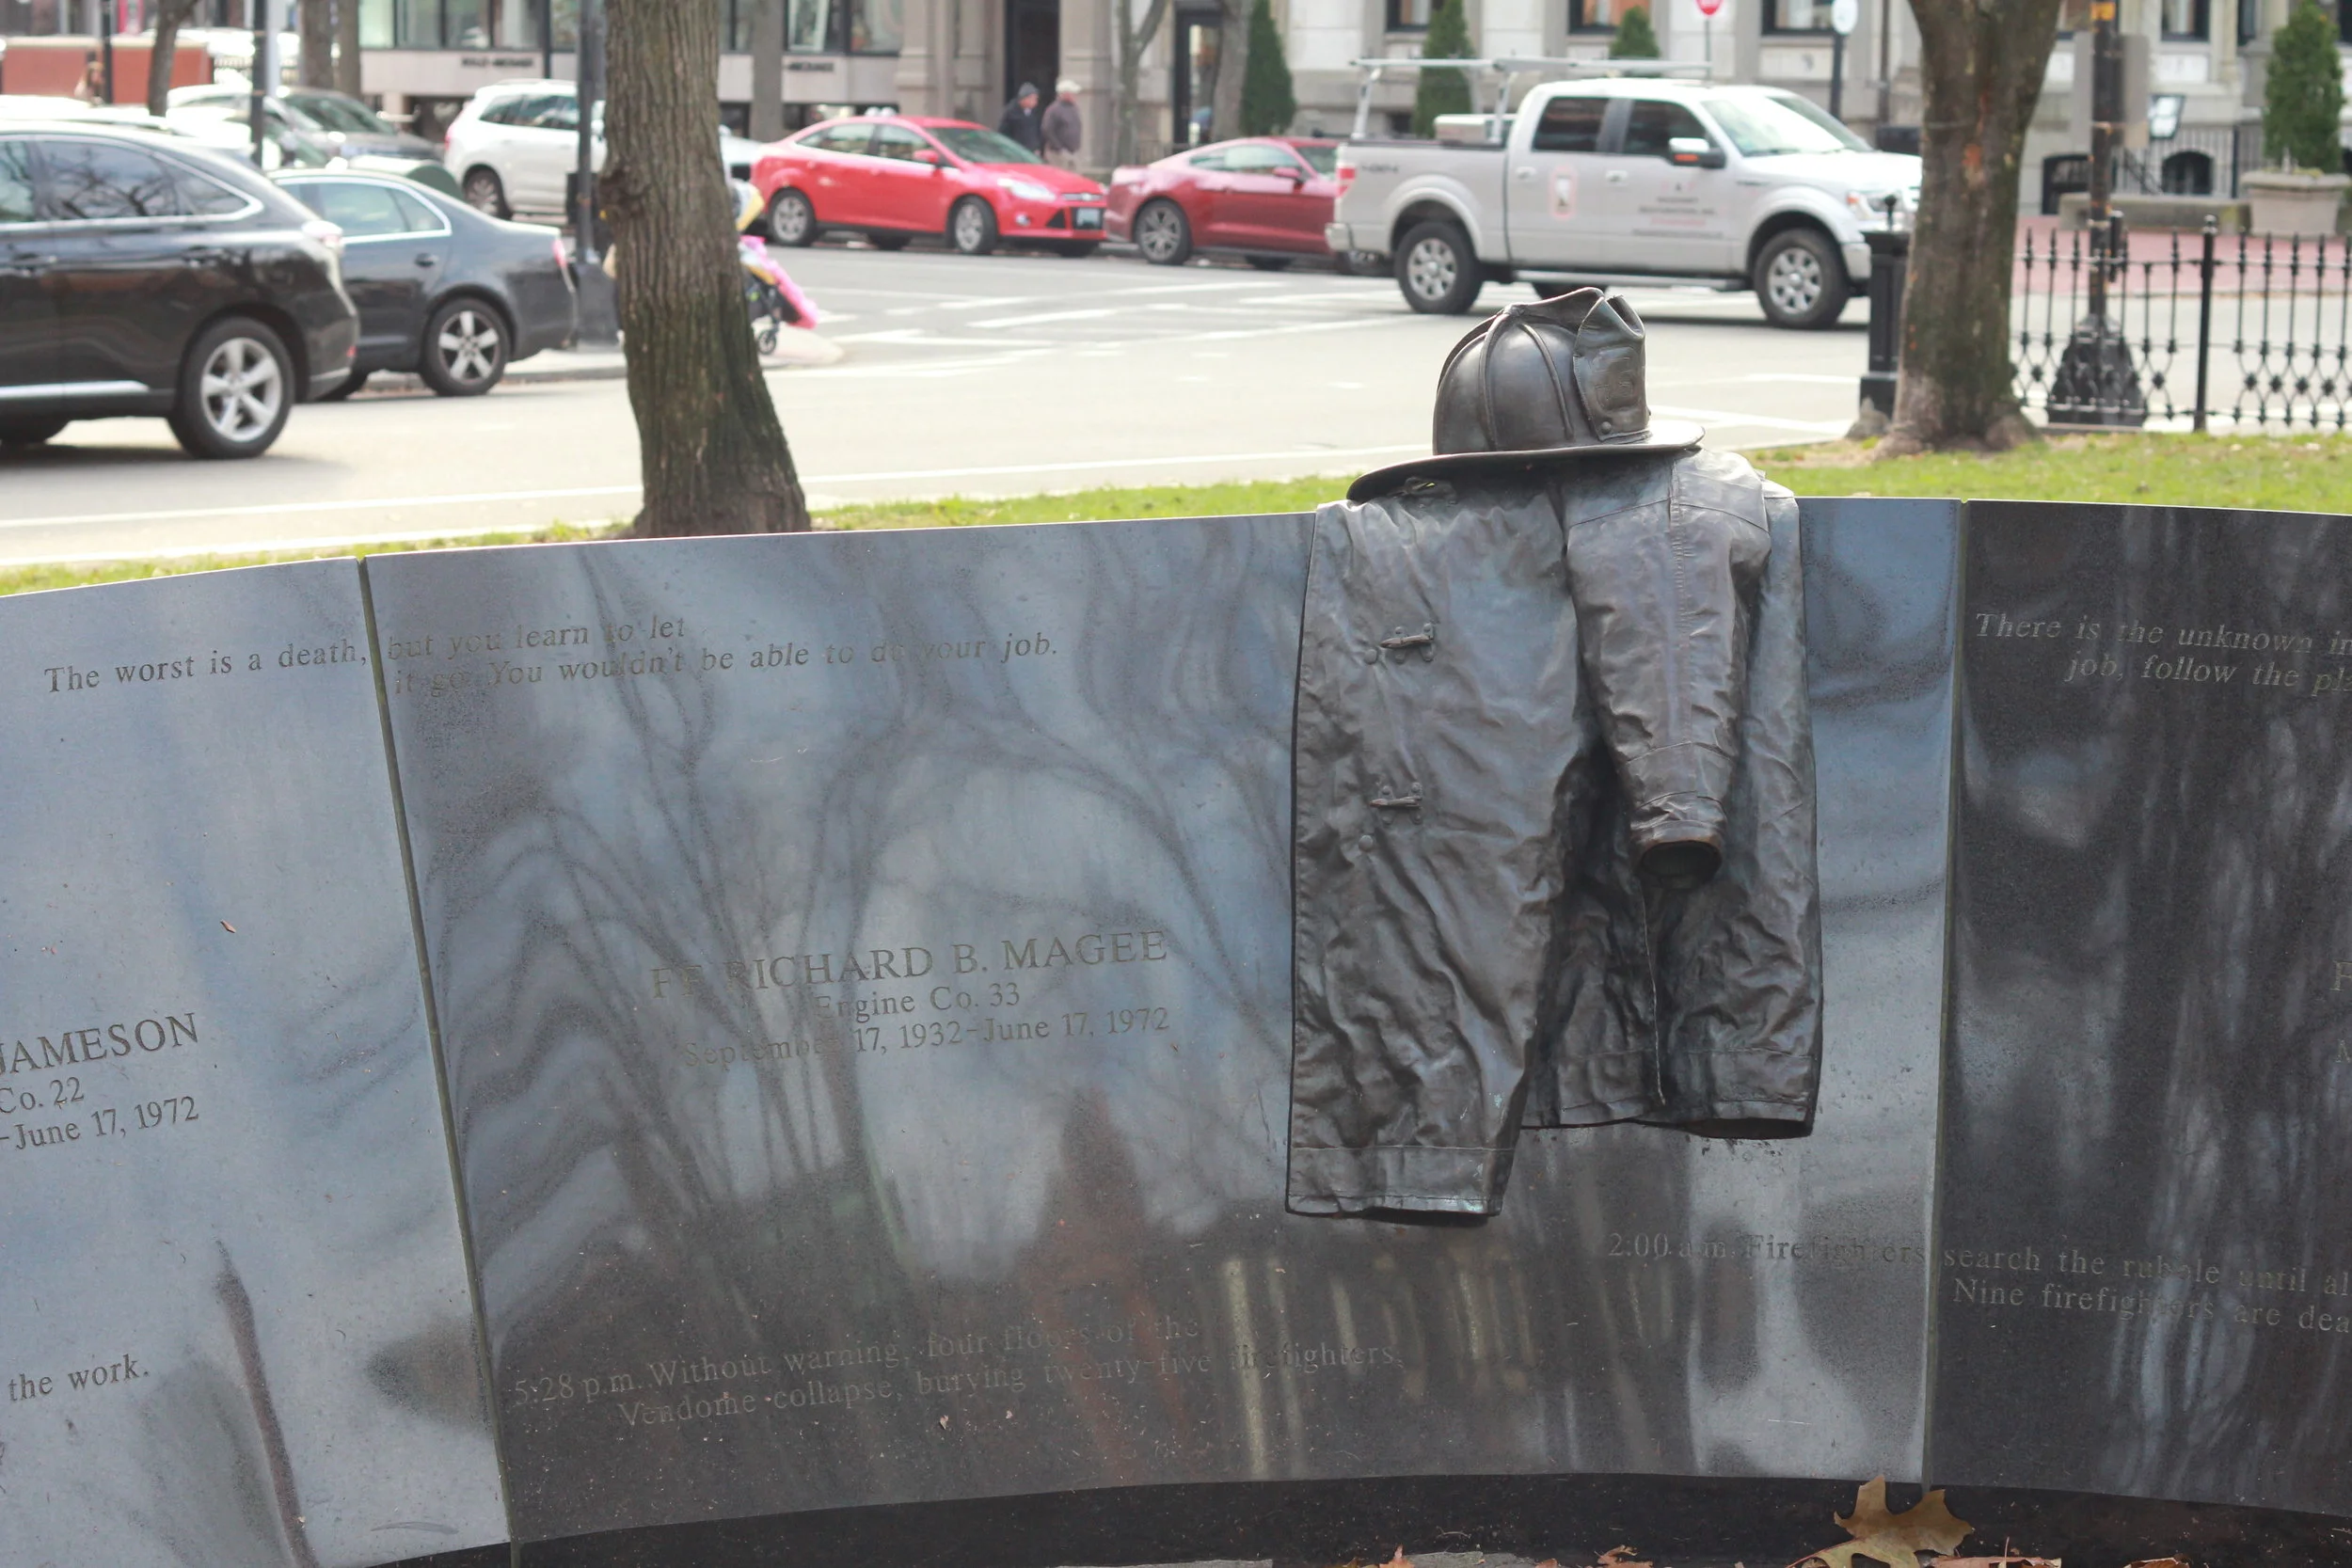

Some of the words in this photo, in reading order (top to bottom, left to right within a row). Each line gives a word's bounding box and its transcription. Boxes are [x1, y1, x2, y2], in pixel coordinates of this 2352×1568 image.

[43, 666, 100, 693] The
[115, 656, 195, 683] worst
[209, 649, 232, 675] is
[247, 653, 262, 672] a
[278, 640, 367, 668] death,
[387, 634, 434, 660] but
[449, 629, 501, 659] you
[516, 625, 589, 649] learn
[604, 622, 633, 643] to
[649, 613, 685, 640] let
[1976, 613, 2062, 638] There
[2074, 614, 2101, 641] is
[2117, 619, 2164, 643] the
[2178, 625, 2312, 654] unknown
[394, 670, 415, 694] it
[487, 660, 543, 689] You
[558, 646, 684, 681] wouldn't
[701, 647, 734, 671] be
[750, 641, 810, 669] able
[826, 643, 854, 664] to
[912, 639, 987, 666] your
[999, 632, 1058, 664] job.
[2064, 650, 2124, 683] job,
[2140, 654, 2238, 685] follow
[2252, 662, 2299, 687] the
[650, 963, 704, 999] FF
[722, 946, 934, 991] RICHARD
[950, 943, 988, 974] B.
[1000, 930, 1168, 971] MAGEE
[815, 990, 915, 1024] Engine
[930, 986, 979, 1011] Co.
[990, 982, 1021, 1006] 33
[854, 1026, 887, 1054] 17,
[1061, 1012, 1095, 1037] 17,
[1106, 1007, 1170, 1035] 1972
[50, 1077, 86, 1109] 22
[91, 1108, 126, 1138] 17,
[135, 1096, 199, 1130] 1972
[1608, 1232, 1669, 1260] 2:00
[1740, 1234, 1925, 1266] Firefighers
[1944, 1246, 2041, 1271] search
[2058, 1249, 2106, 1275] the
[2238, 1267, 2306, 1292] until
[1953, 1278, 2024, 1306] Nine
[2042, 1283, 2215, 1322] firefighers
[2234, 1304, 2281, 1326] are
[8, 1373, 54, 1402] the
[68, 1354, 150, 1391] work.
[515, 1373, 575, 1406] 5:28
[647, 1355, 772, 1387] Without
[783, 1341, 911, 1375] warning,
[926, 1330, 989, 1359] four
[1003, 1323, 1090, 1352] floos
[1106, 1318, 1137, 1344] of
[1155, 1315, 1200, 1340] the
[617, 1393, 757, 1427] Vendome
[773, 1380, 903, 1410] collapse,
[915, 1363, 1027, 1399] burying
[1043, 1353, 1212, 1385] twenty-five
